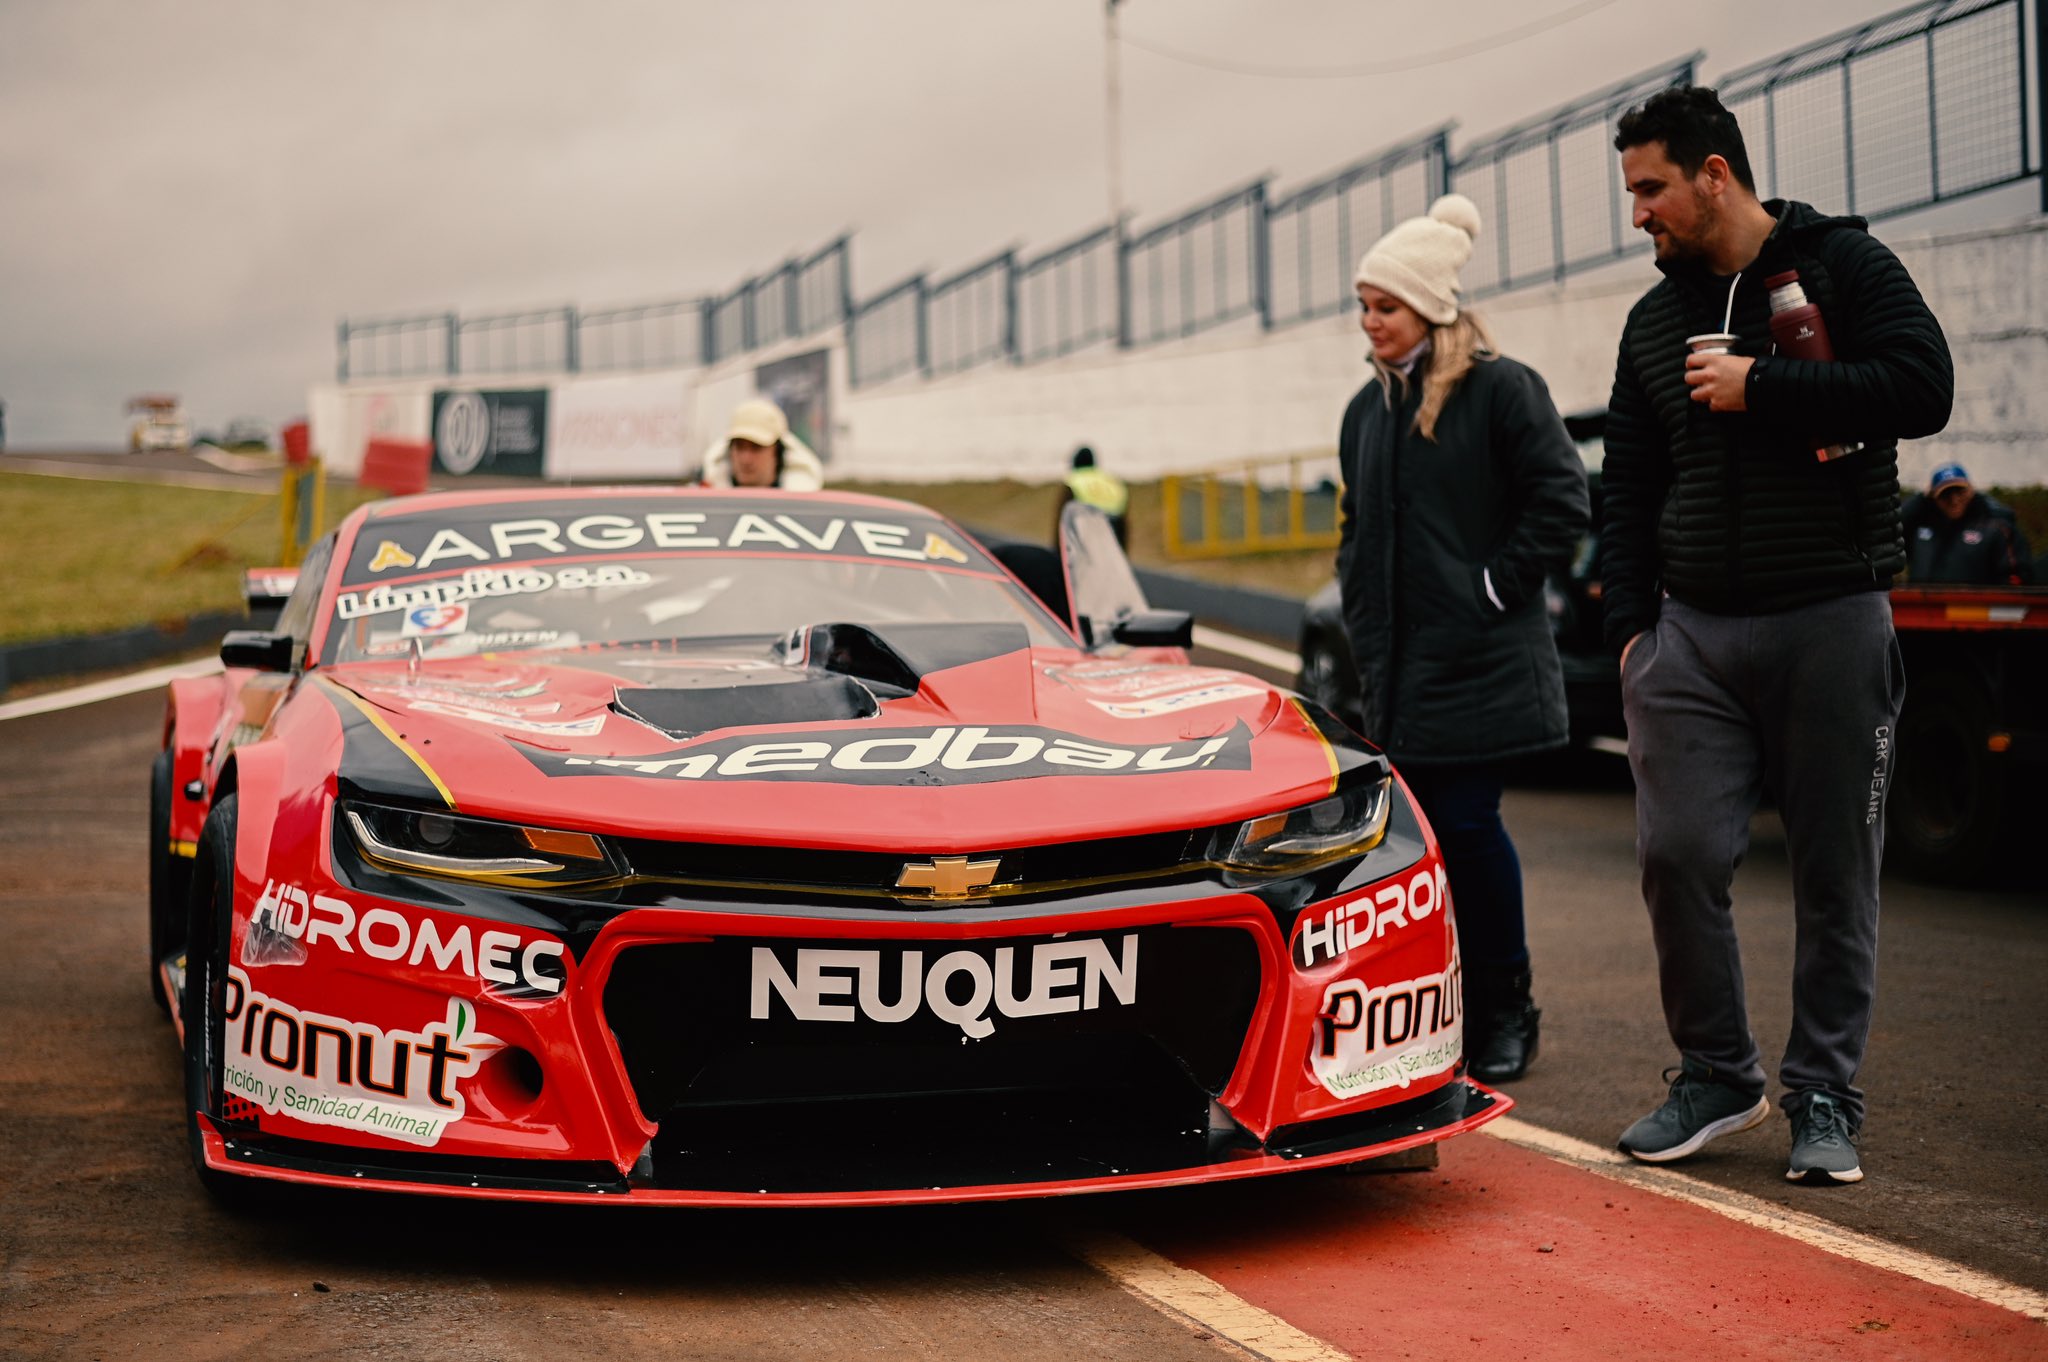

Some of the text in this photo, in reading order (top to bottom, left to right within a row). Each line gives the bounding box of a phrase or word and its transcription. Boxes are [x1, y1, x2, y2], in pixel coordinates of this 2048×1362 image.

[416, 513, 928, 569] ARGEAVE
[1866, 725, 1889, 824] CRK JEANS
[224, 1064, 438, 1137] rición y Sanidad Animal
[1391, 1062, 1403, 1080] y
